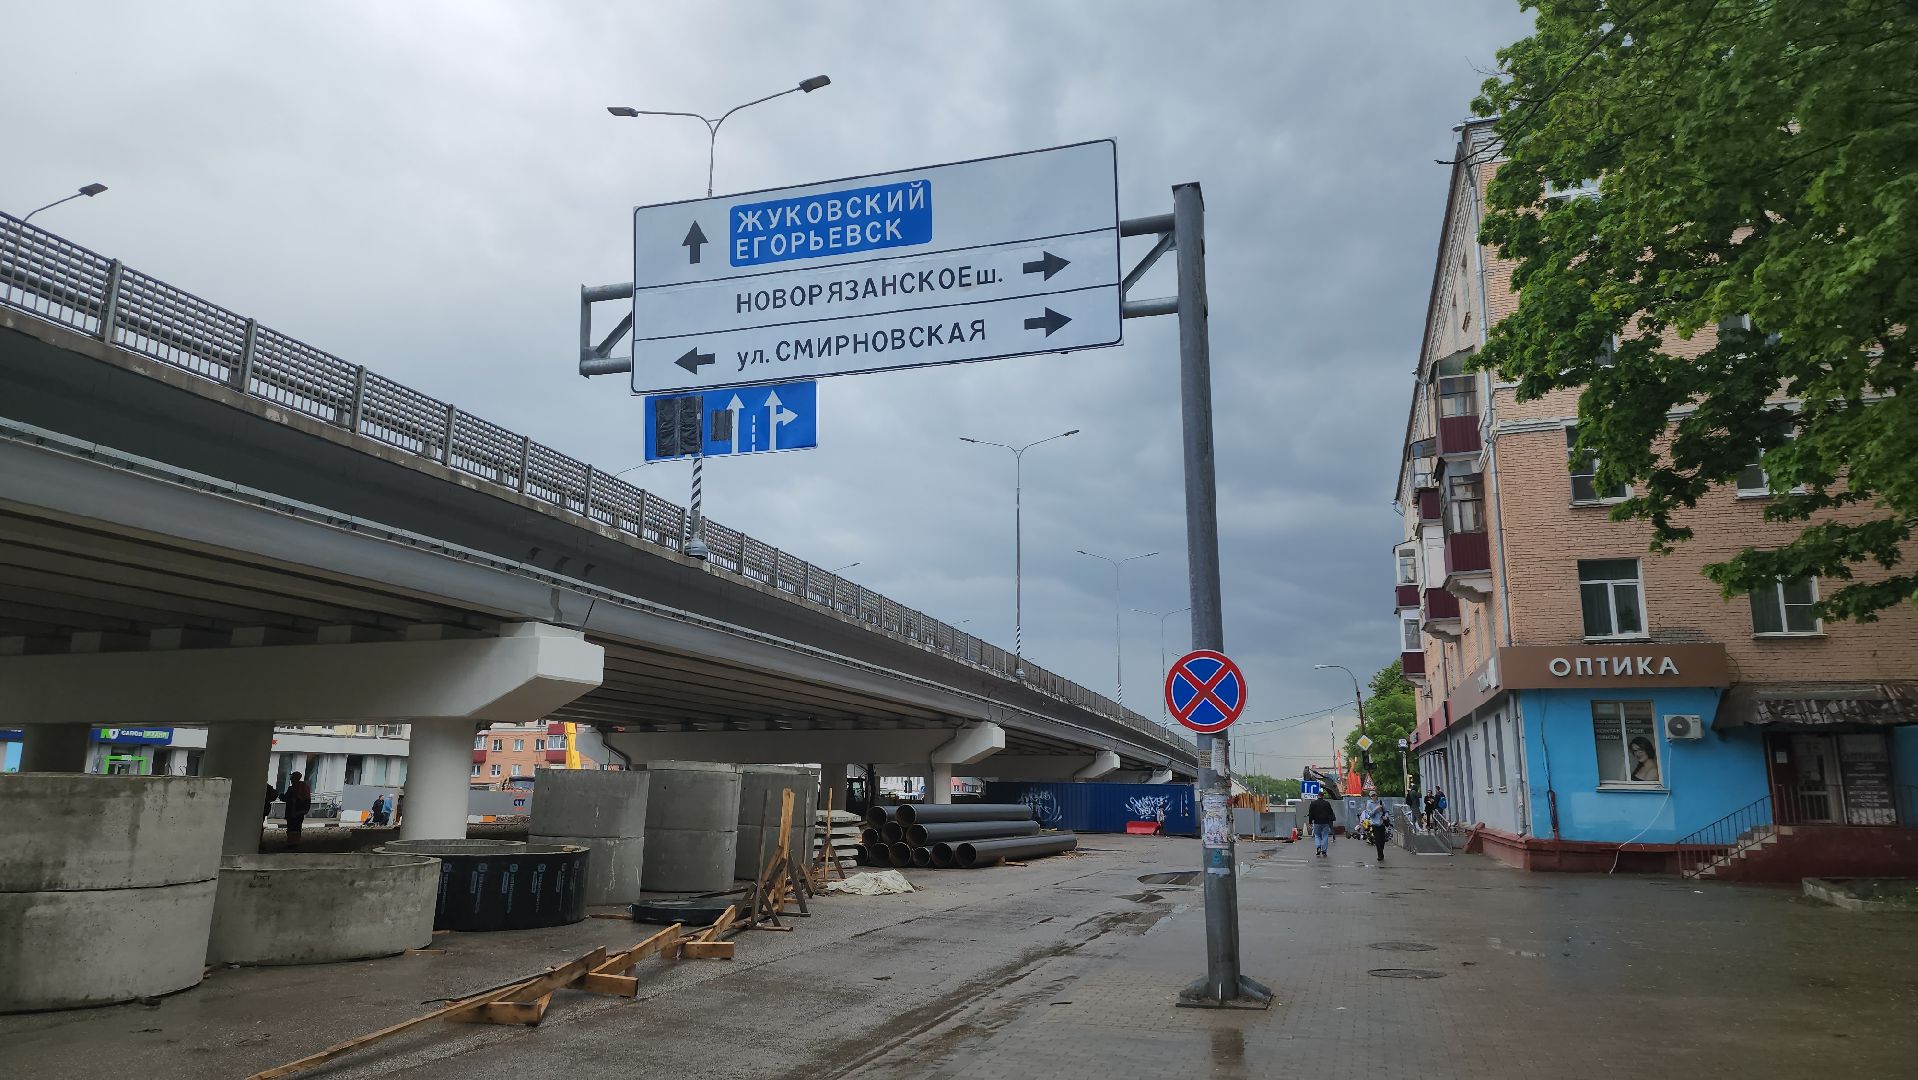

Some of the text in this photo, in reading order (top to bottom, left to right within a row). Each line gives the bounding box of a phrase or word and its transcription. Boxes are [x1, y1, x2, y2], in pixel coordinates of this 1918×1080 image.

[737, 181, 925, 233] ЖУКОВСКИЙ
[736, 217, 903, 260] ЕГОРЬЕВСК
[1549, 656, 1680, 677] ОПТИКА
